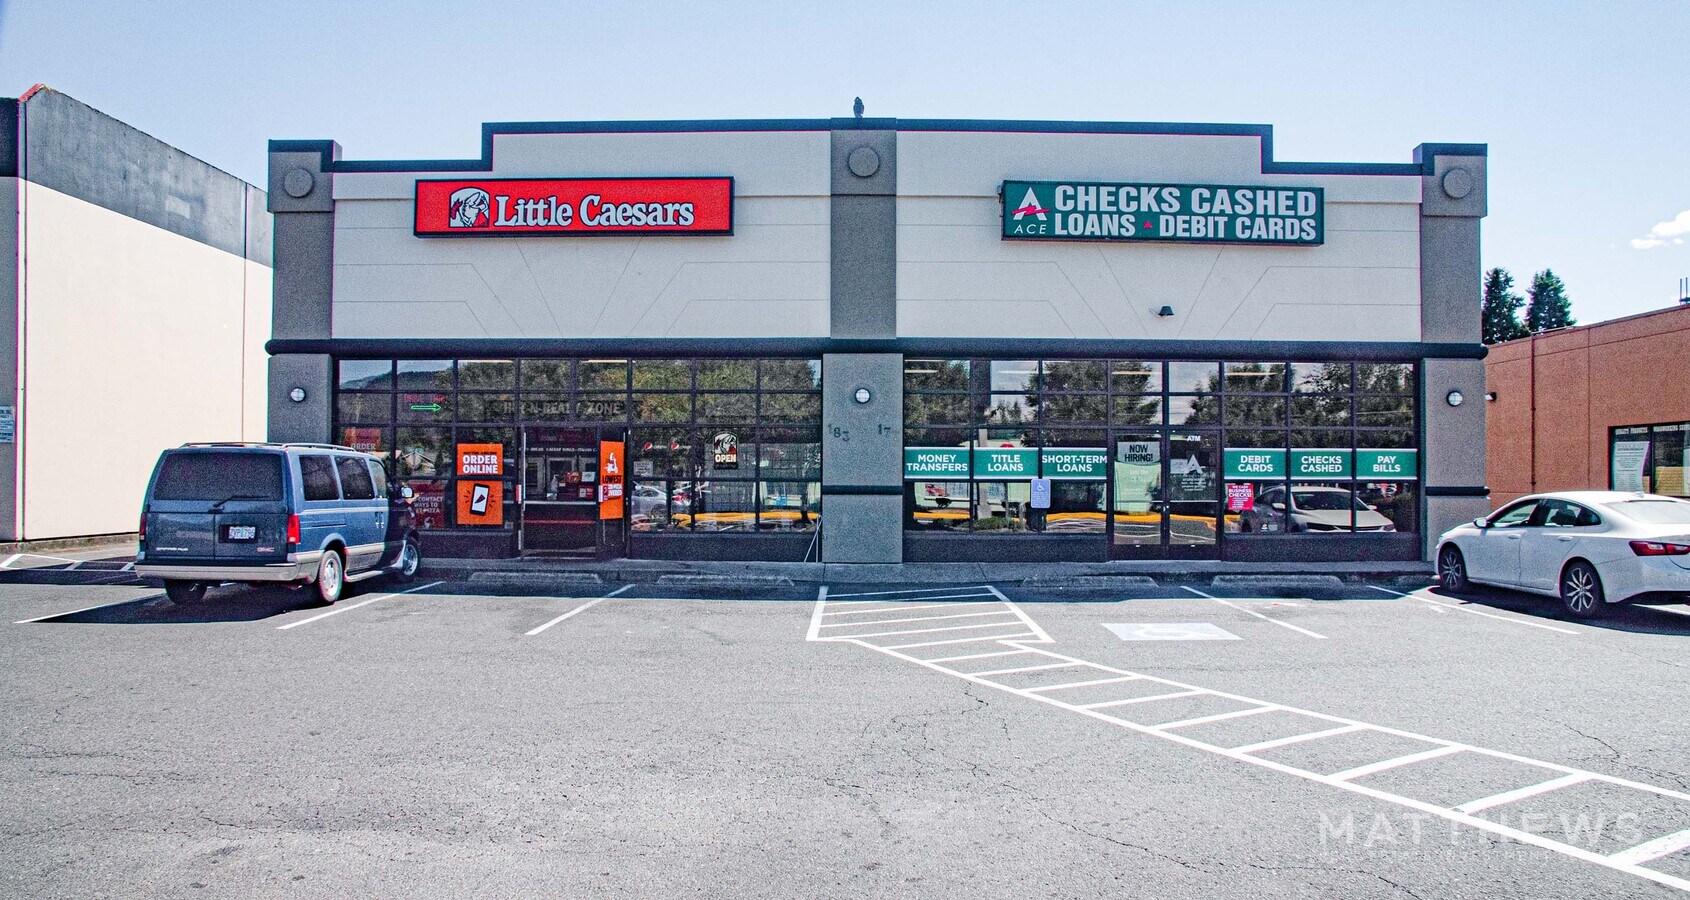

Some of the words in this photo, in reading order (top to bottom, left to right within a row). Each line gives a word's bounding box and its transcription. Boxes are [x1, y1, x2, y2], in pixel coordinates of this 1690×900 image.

[1054, 184, 1181, 213] CHECKS
[1190, 187, 1317, 217] CASHED
[495, 195, 573, 227] Little
[579, 194, 695, 227] Caesars
[1013, 223, 1048, 235] ACE
[1054, 213, 1136, 236] LOANS
[1159, 215, 1228, 238] DEBIT
[1235, 217, 1317, 240] CARDS
[1129, 444, 1148, 453] NOW
[462, 454, 498, 465] ORDER
[715, 454, 737, 463] OPEN
[917, 454, 956, 463] MONEY
[991, 454, 1020, 463] TITLE
[1042, 455, 1107, 464] SHORT-TERM
[1124, 453, 1154, 462] HIRING!
[1240, 455, 1271, 464] DEBIT
[1301, 455, 1342, 464] CHECKS
[1377, 455, 1396, 464] PAY
[462, 464, 498, 474] ONLINE
[906, 463, 968, 472] TRANSFERS
[987, 463, 1024, 472] LOANS
[1056, 463, 1092, 472] LOANS
[1238, 464, 1274, 472] CARDS
[1301, 464, 1343, 473] CASHED
[1373, 464, 1401, 472] BILLS
[602, 474, 622, 484] LOWEST
